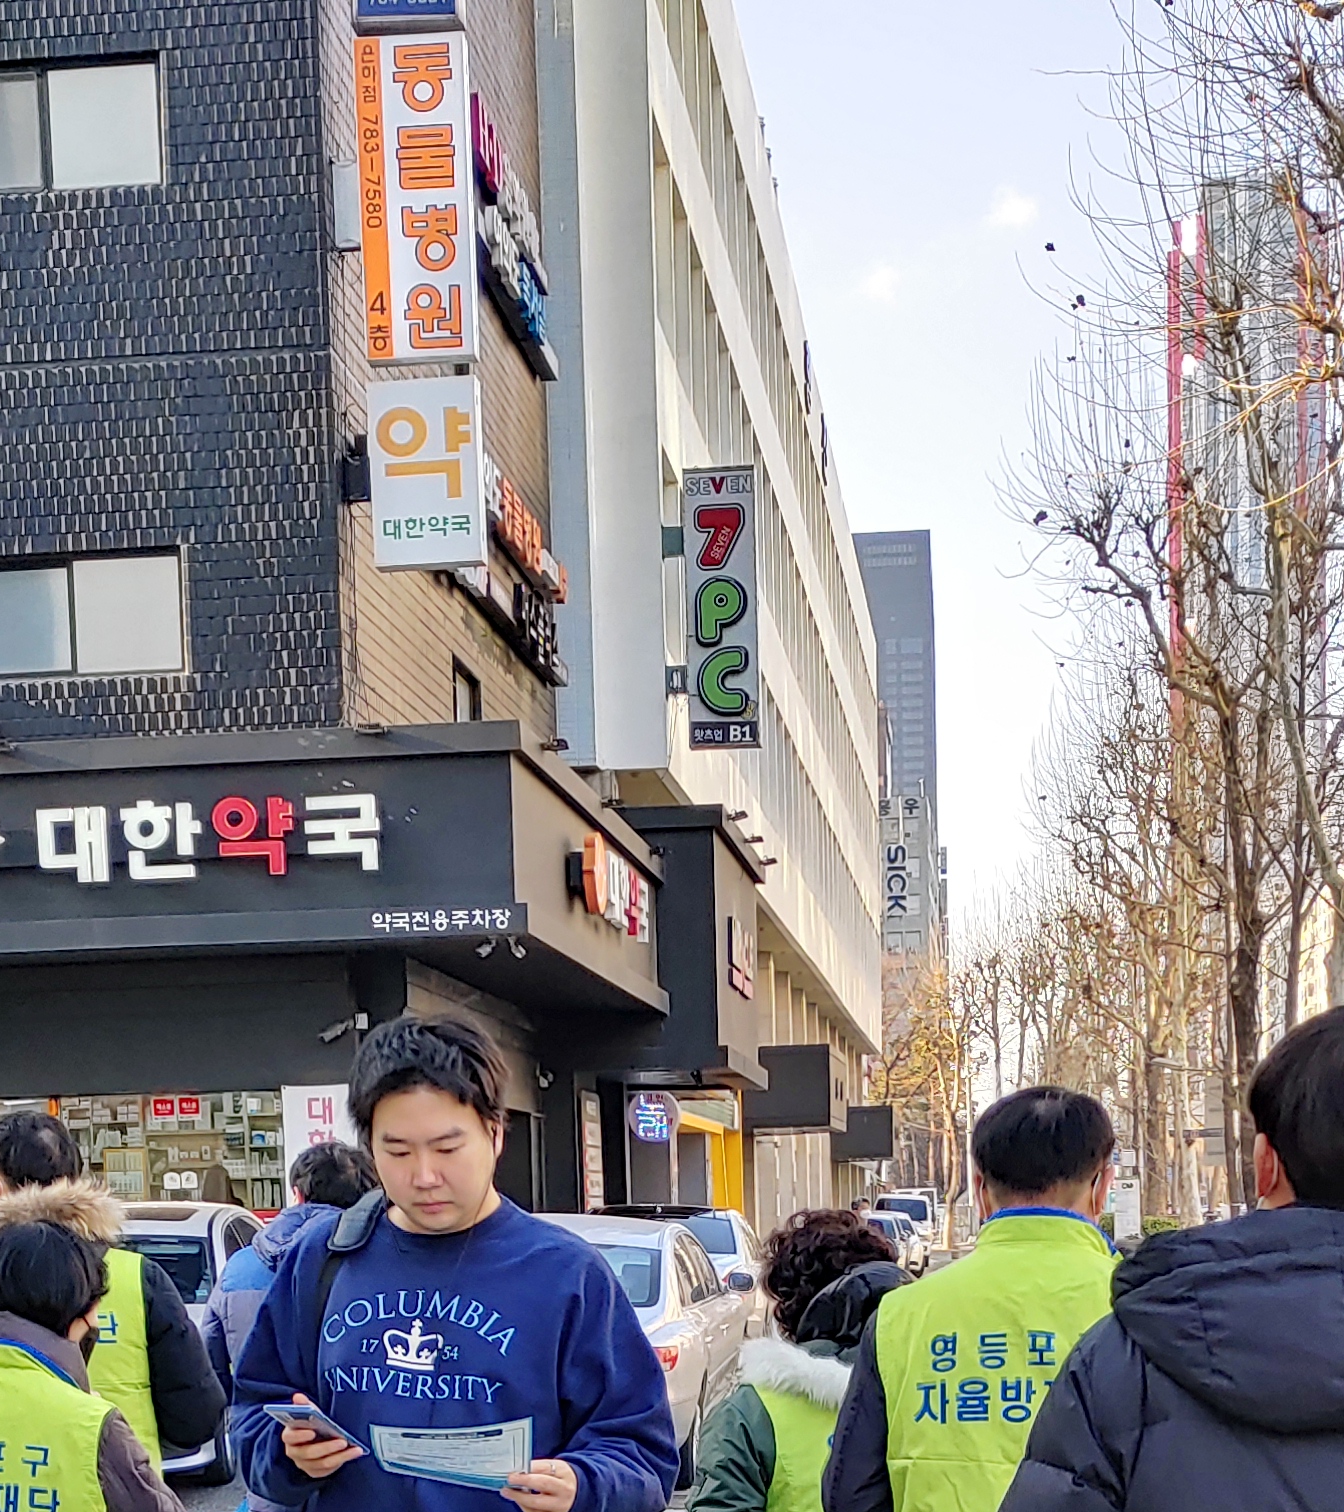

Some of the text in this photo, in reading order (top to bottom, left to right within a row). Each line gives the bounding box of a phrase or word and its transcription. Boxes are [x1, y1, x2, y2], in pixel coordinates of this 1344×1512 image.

[362, 114, 383, 230] 783-7580
[392, 42, 463, 349] 동물병원
[368, 289, 391, 352] 4층
[375, 406, 472, 499] 약
[685, 473, 752, 496] SEVEN
[382, 513, 472, 541] 대한약국
[710, 525, 731, 560] SEVEN
[729, 724, 753, 742] B1
[35, 792, 380, 884] 대한약국
[886, 844, 907, 914] SICK
[370, 908, 512, 933] 약국전용주차장
[323, 1289, 517, 1356] COLUMBIA
[360, 1338, 460, 1360] 17 54
